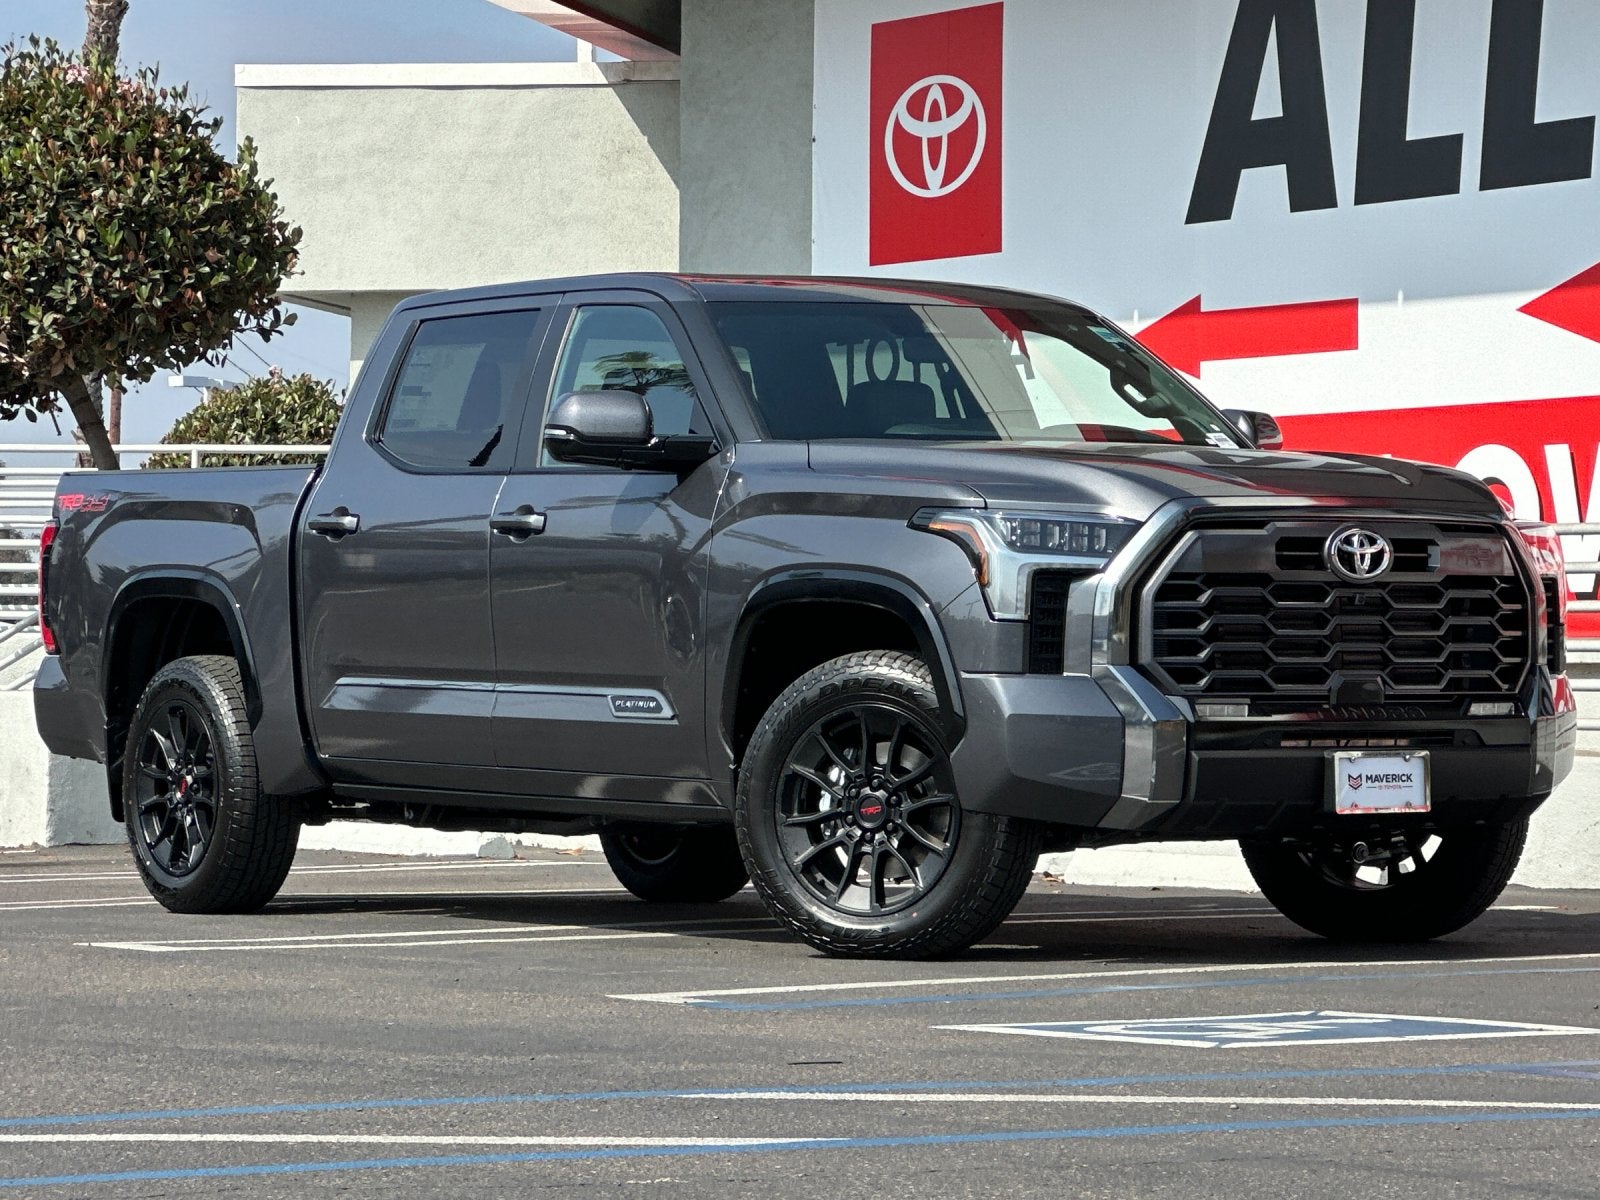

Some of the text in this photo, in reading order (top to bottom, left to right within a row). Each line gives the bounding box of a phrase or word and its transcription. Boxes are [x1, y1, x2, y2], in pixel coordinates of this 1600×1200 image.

[1184, 0, 1596, 225] ALL
[58, 494, 84, 511] TRD
[615, 700, 657, 708] PLATINUM
[1365, 773, 1413, 784] MAVERICK
